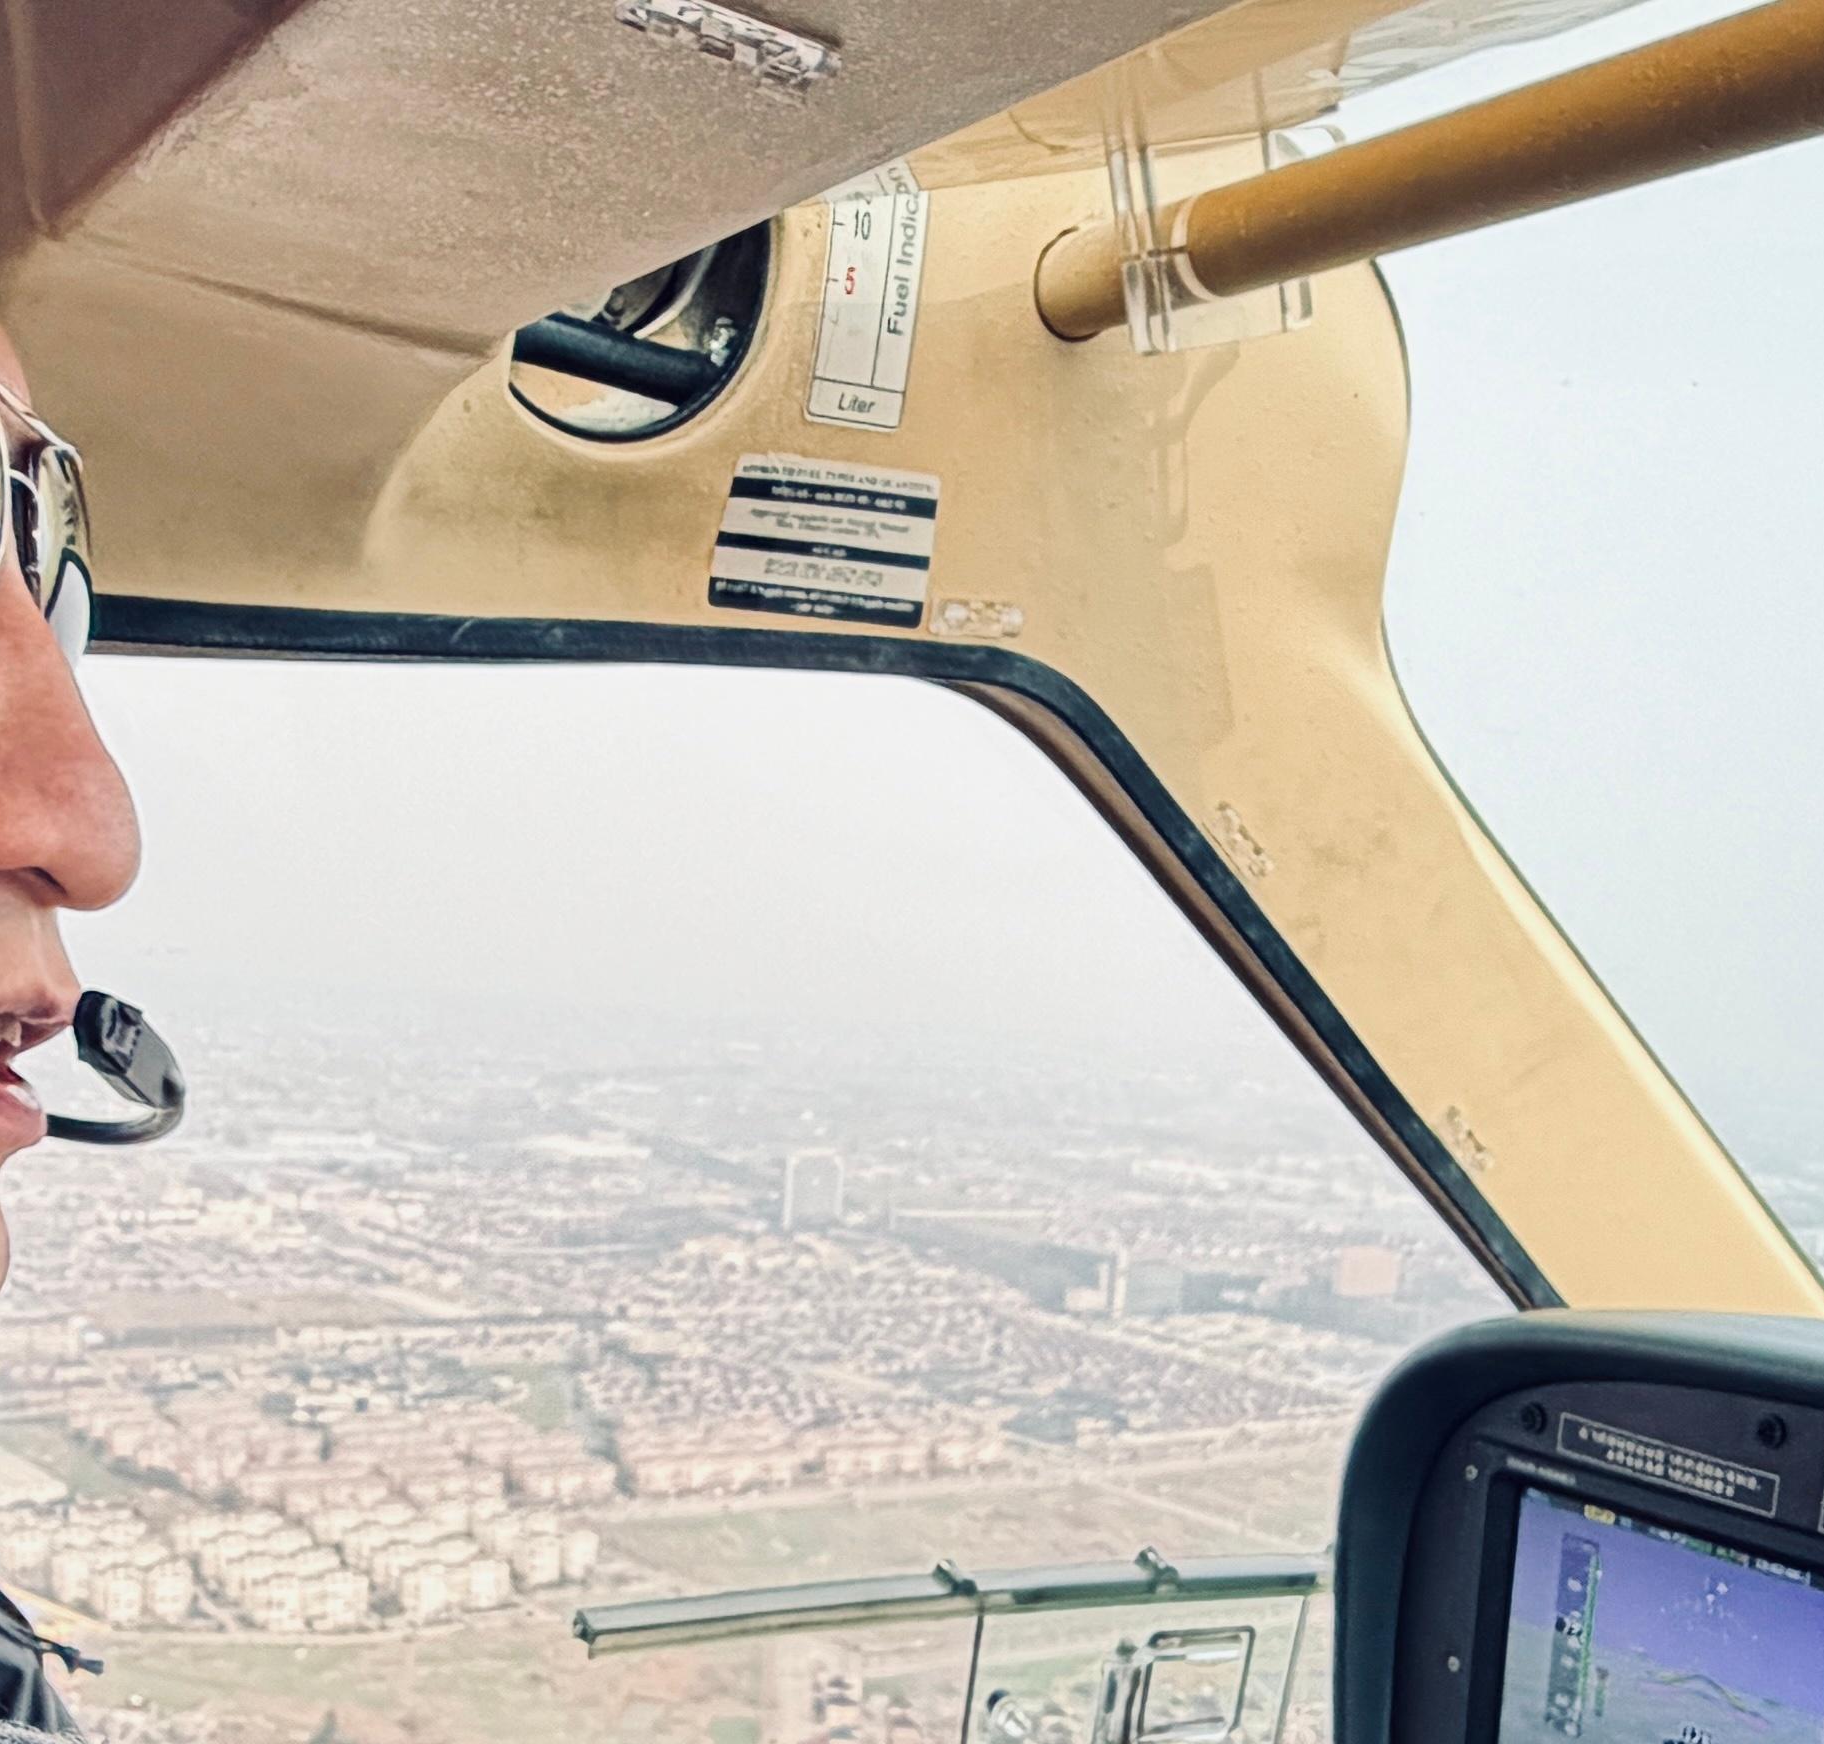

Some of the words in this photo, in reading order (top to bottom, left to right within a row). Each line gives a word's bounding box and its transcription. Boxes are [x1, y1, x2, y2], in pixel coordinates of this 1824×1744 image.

[853, 208, 873, 241] 10
[843, 265, 857, 295] 5
[886, 275, 911, 336] Fuel
[836, 391, 877, 415] Liter
